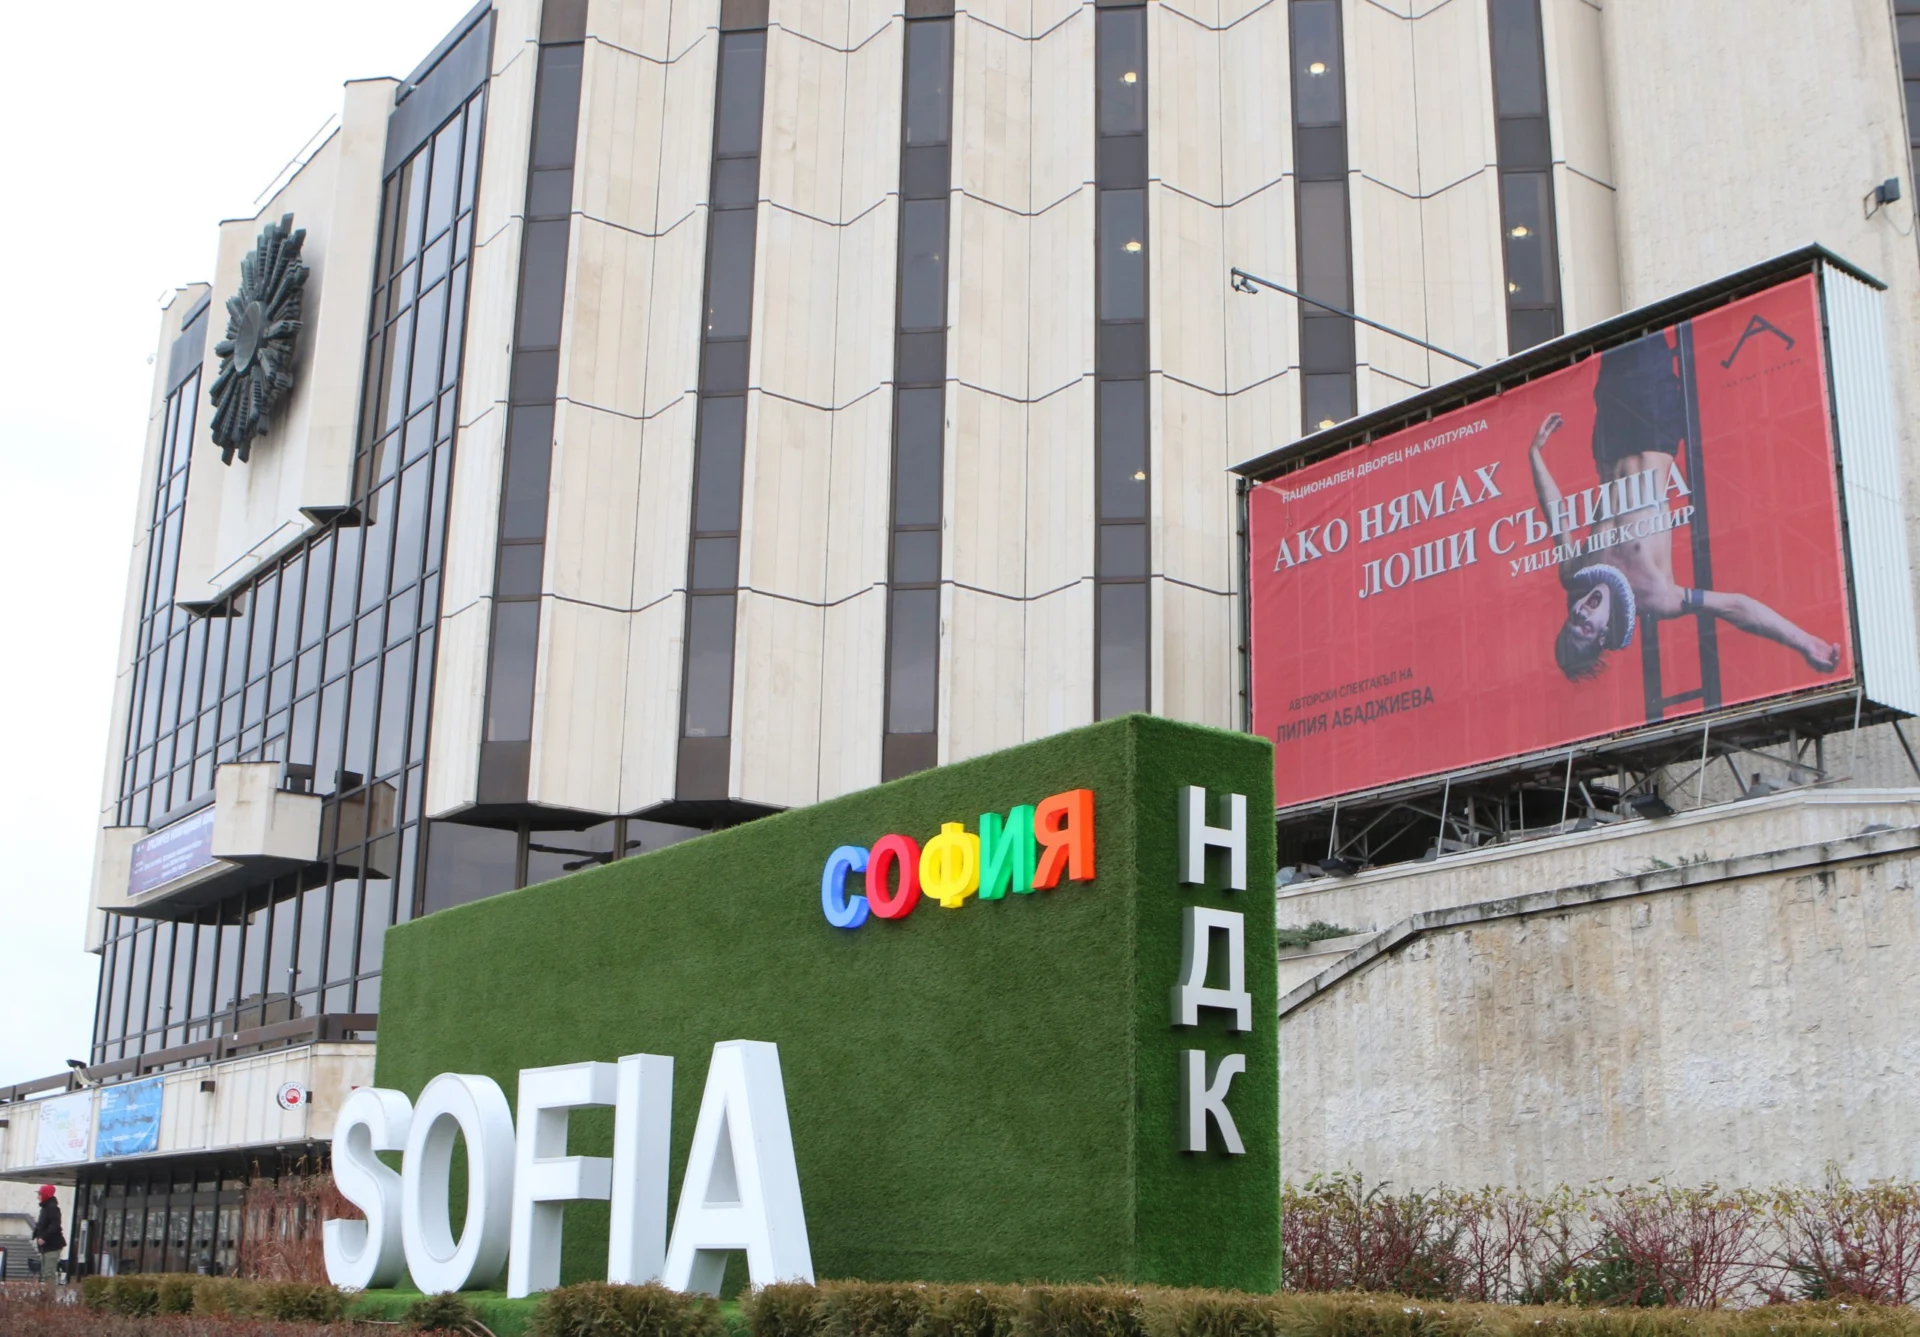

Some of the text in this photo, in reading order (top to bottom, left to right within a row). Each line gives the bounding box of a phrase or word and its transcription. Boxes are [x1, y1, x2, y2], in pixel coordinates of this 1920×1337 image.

[1273, 461, 1502, 572] АКО НЯМАХ
[1282, 419, 1488, 503] НАЦИОНАЛЕН ДВОРЕЦ НА КУЛТУРАТА
[1358, 461, 1692, 599] ЛОШИ СЪНИЩА
[1509, 505, 1695, 577] УИЛЯМ ШЕКСПИР
[1276, 686, 1434, 744] ЛИЛИЯ АБАДЖИЕВА
[1288, 667, 1413, 711] АВТОРСКИ СПЕКТАКЪЛ НА
[822, 788, 1096, 929] СОФИЯ
[1172, 785, 1252, 1155] НДК
[322, 1039, 815, 1298] SOFIA
